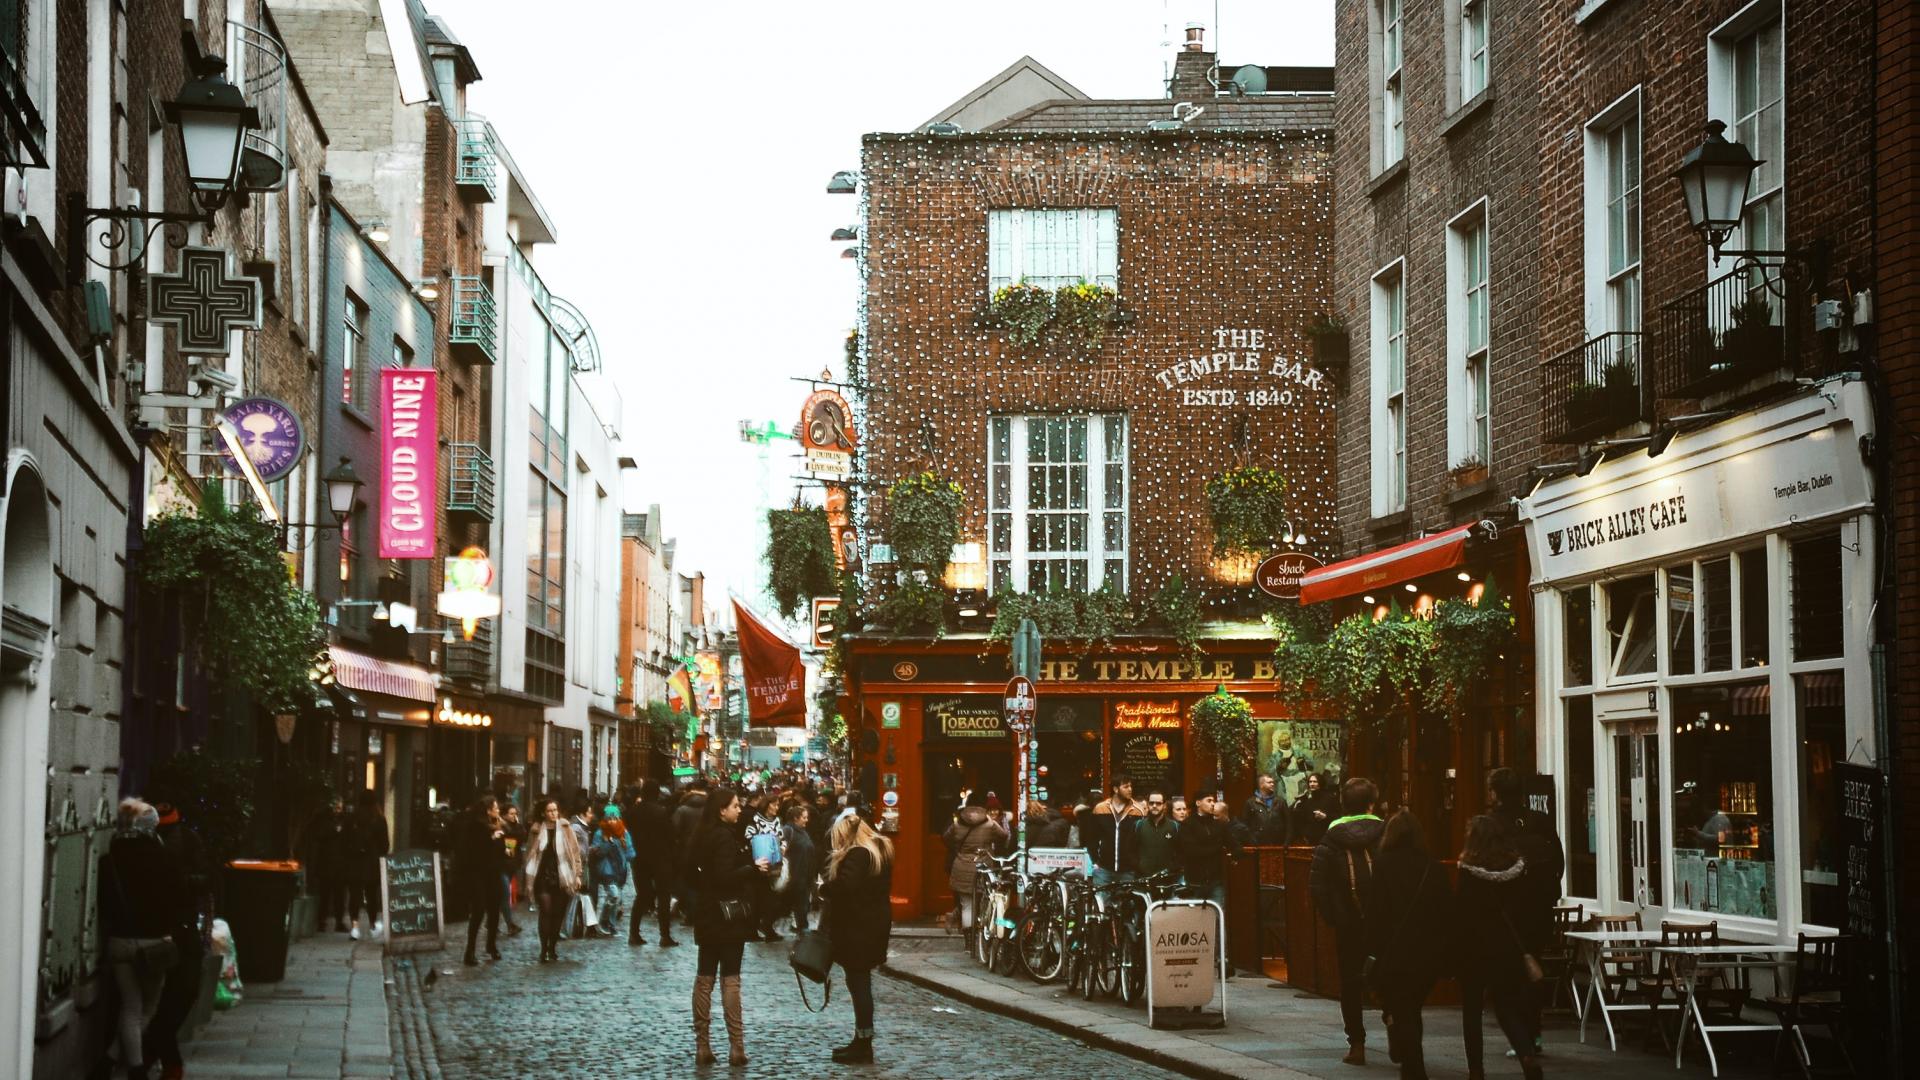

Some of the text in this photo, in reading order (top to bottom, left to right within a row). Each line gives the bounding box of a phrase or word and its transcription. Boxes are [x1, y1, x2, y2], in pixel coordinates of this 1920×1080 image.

[1213, 329, 1265, 348] THE
[1155, 351, 1324, 391] TEMPLE BAR
[1247, 389, 1293, 406] 1840
[392, 375, 426, 438] NINE
[227, 403, 296, 438] EAL'S YARD
[268, 439, 296, 447] GARDEN
[816, 451, 842, 459] DUBLIN
[811, 463, 825, 471] LIVE
[391, 446, 425, 532] CLOUD
[1773, 474, 1833, 499] Temple Bar, Dublin
[1566, 486, 1687, 552] BRICK ALLEY CAFÉ
[897, 664, 913, 676] 48
[1037, 661, 1079, 681] HE
[1093, 660, 1235, 681] TEMPLE
[750, 680, 800, 697] TEMPLE
[764, 676, 786, 685] THE
[765, 693, 788, 705] BAR
[1116, 702, 1177, 716] Traditional
[938, 713, 999, 734] TOBACCO
[1114, 716, 1180, 729] Irish Music
[1125, 735, 1153, 748] TEMPLE
[1309, 739, 1339, 752] BAR
[1843, 780, 1871, 801] BRICK
[1156, 932, 1209, 947] ARIOSA
